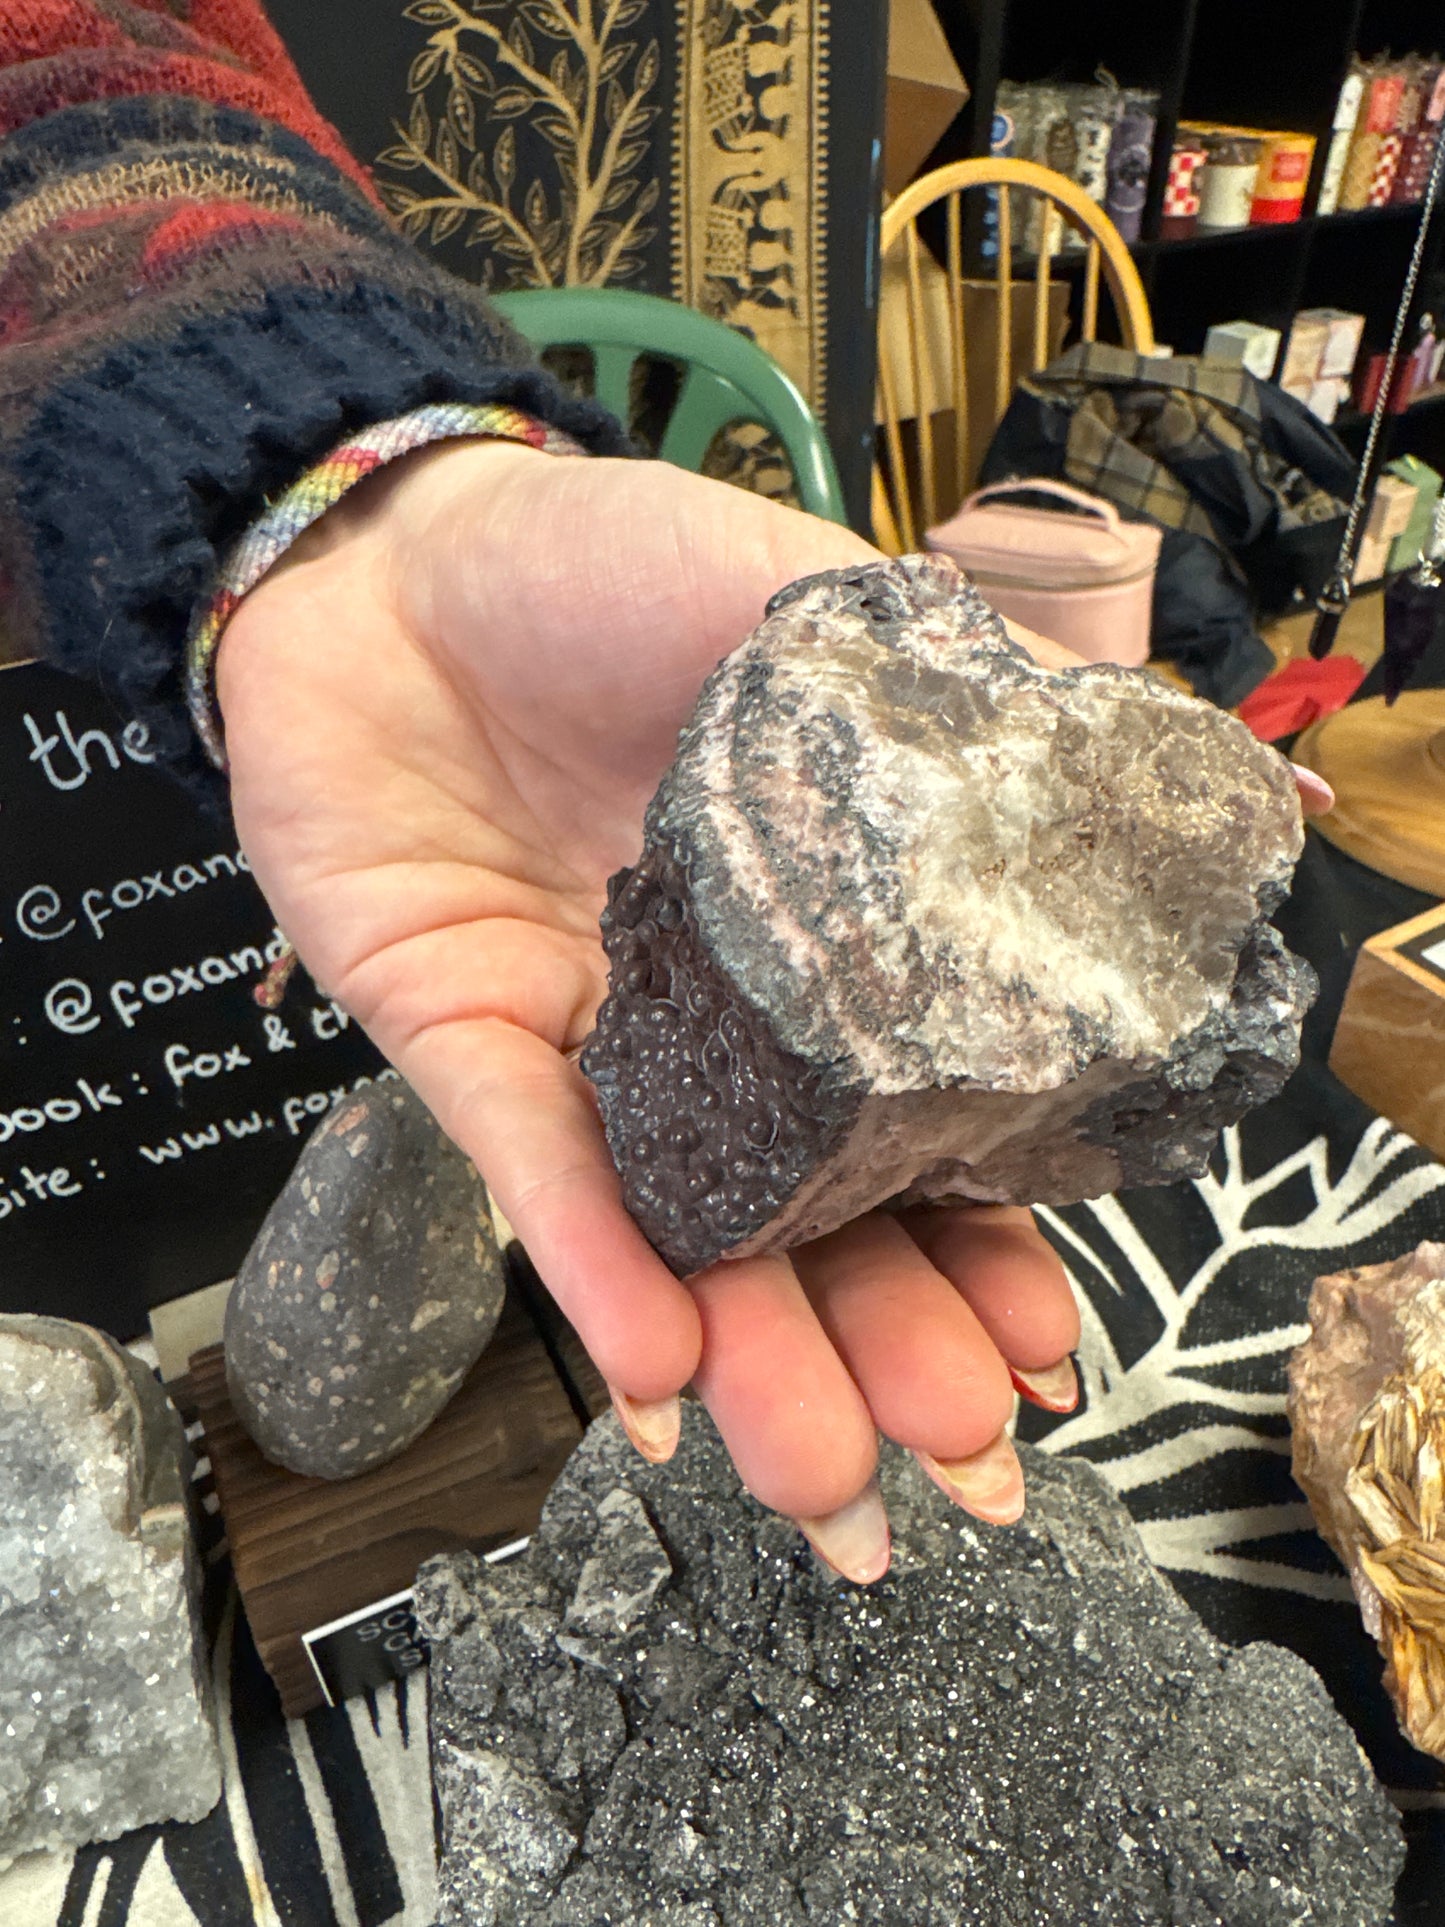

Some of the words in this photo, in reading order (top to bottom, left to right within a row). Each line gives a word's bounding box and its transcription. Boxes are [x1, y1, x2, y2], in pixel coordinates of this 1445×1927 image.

[23, 710, 156, 790] the
[165, 1043, 251, 1086] fox
[262, 1014, 297, 1052] &
